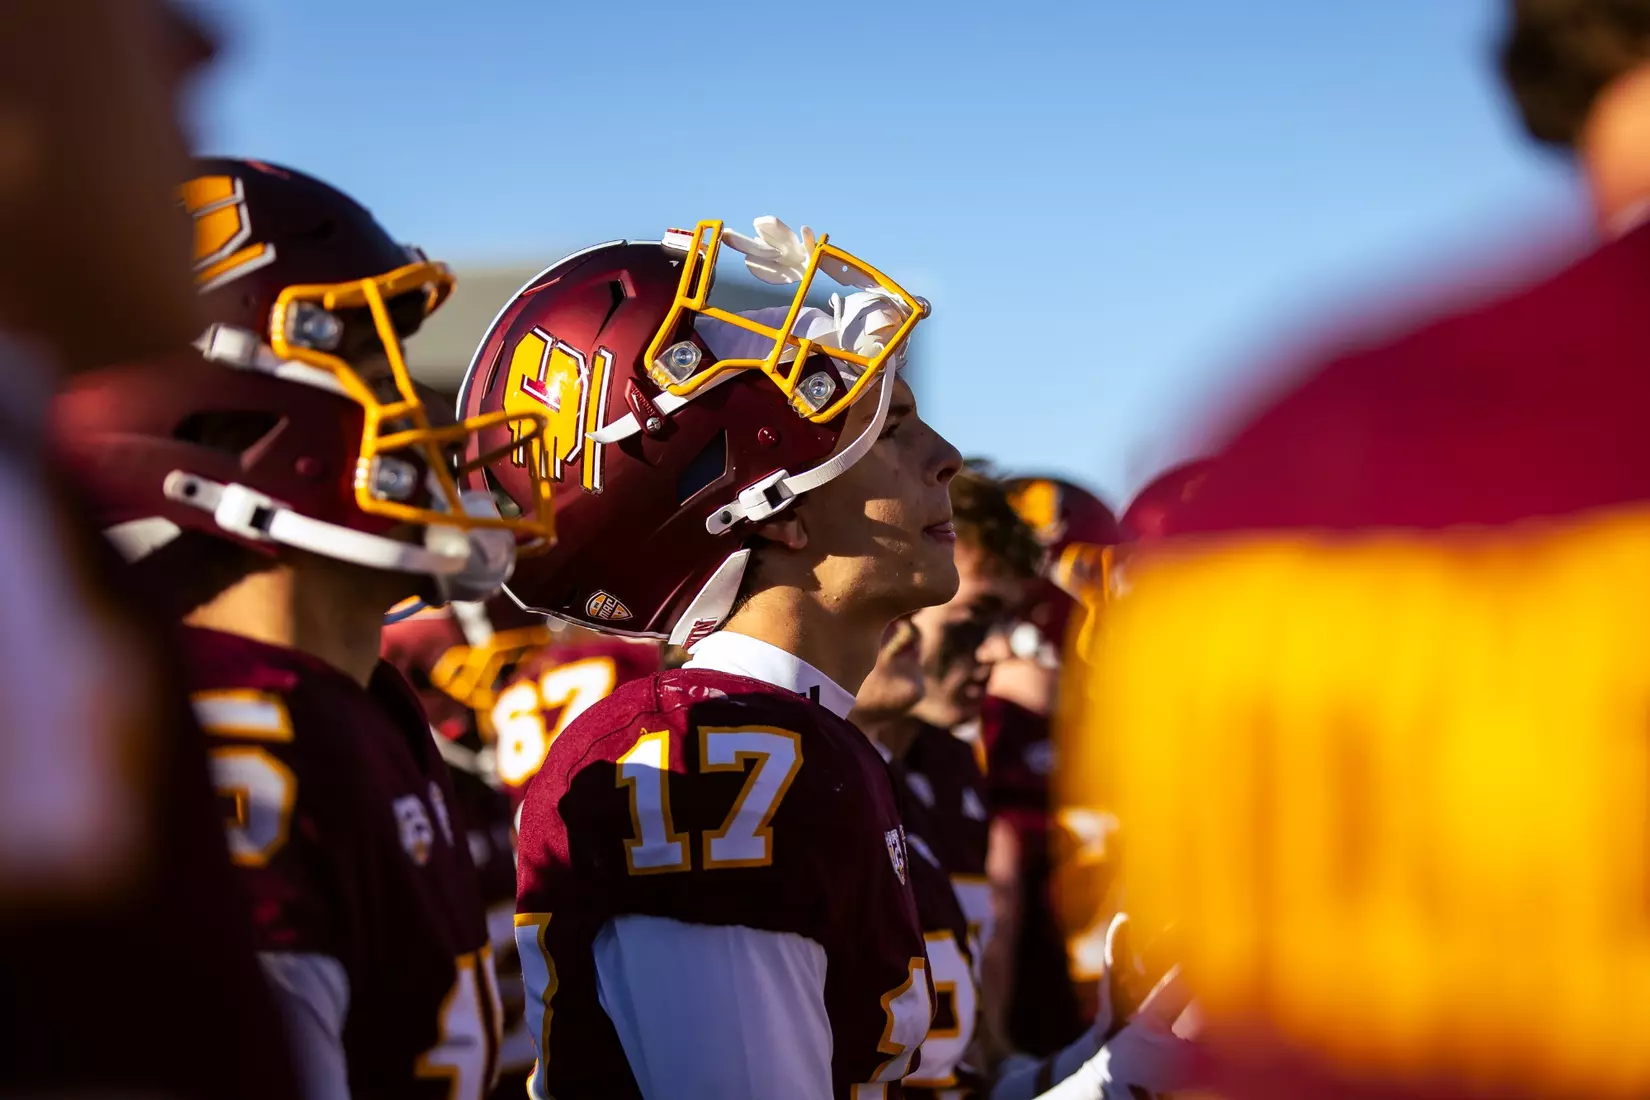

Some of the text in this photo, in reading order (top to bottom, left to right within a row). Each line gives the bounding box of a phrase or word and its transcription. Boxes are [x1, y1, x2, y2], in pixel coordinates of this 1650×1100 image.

[598, 597, 618, 620] MAC
[491, 656, 617, 787] 67
[615, 725, 803, 876] 17
